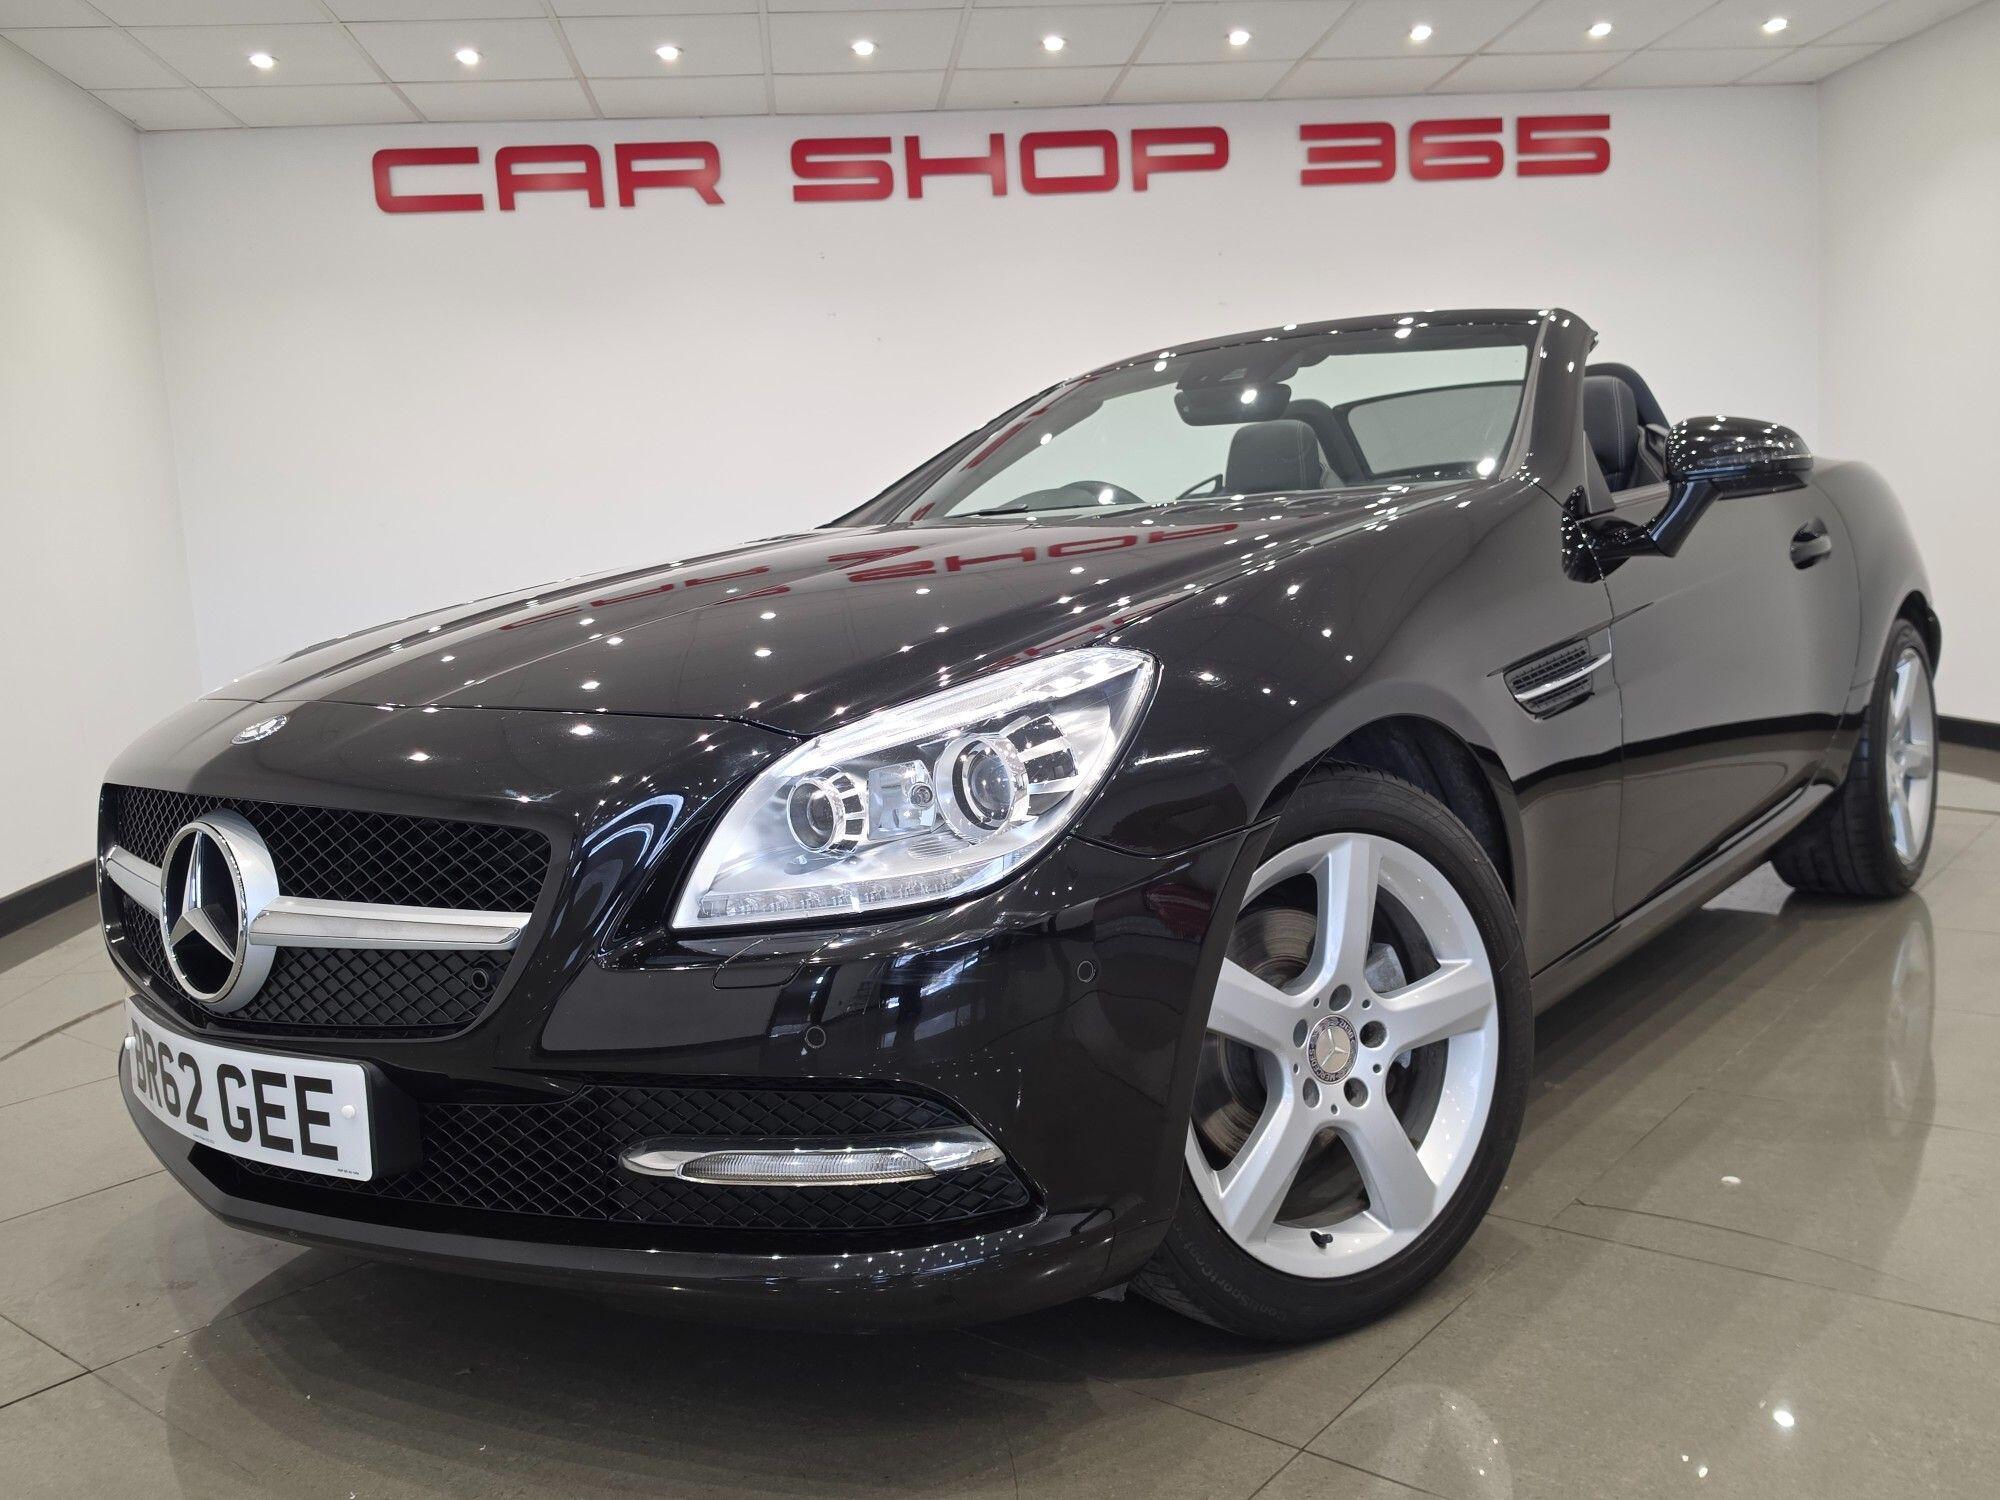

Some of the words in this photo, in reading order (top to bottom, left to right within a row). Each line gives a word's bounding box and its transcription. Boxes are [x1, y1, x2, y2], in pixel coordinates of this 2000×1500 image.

[372, 146, 726, 213] CAR
[790, 127, 1229, 201] SHOP
[1300, 115, 1610, 186] 365
[131, 1017, 209, 1132] BR62
[216, 1063, 339, 1162] GEE
